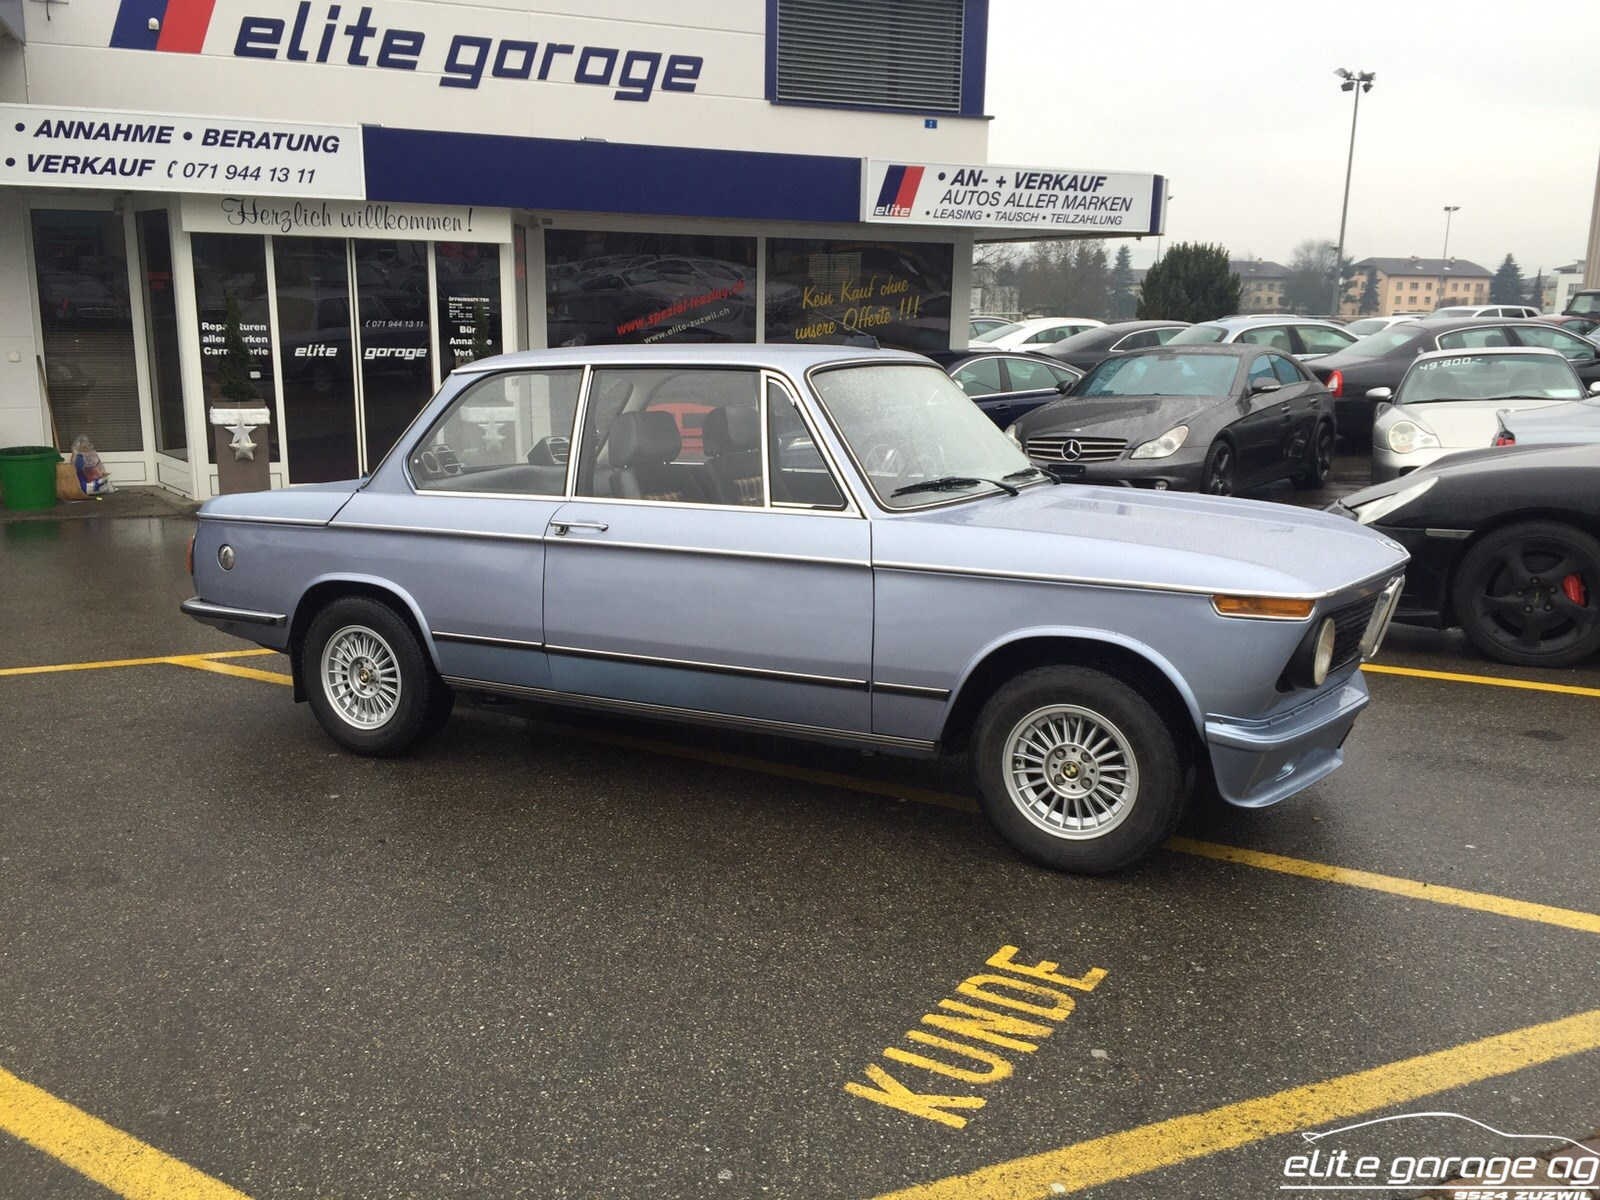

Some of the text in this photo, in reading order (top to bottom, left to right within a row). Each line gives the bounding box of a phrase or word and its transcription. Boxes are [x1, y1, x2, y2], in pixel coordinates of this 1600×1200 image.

[234, 0, 703, 102] elite garage
[34, 119, 340, 153] ANNAHME BERATUNG
[27, 154, 316, 184] VERKAUF 071 944 13 11
[950, 169, 988, 187] AN-
[1014, 171, 1108, 193] VERKAUF
[221, 197, 472, 232] Herzlich willkommen!
[873, 205, 910, 218] elite
[939, 189, 1134, 212] AUTOS ALLER MARKEN
[932, 208, 1123, 226] LEASING TAUSCH TEILZAHLUNG
[802, 274, 909, 310] Kein Kauf ohne
[202, 322, 267, 332] Repturen
[643, 307, 731, 344] www.elite-zuzwil.ch
[795, 321, 836, 340] unsere
[842, 306, 892, 330] Offerte
[294, 345, 428, 360] elite garage
[844, 944, 1109, 1129] KUNDE
